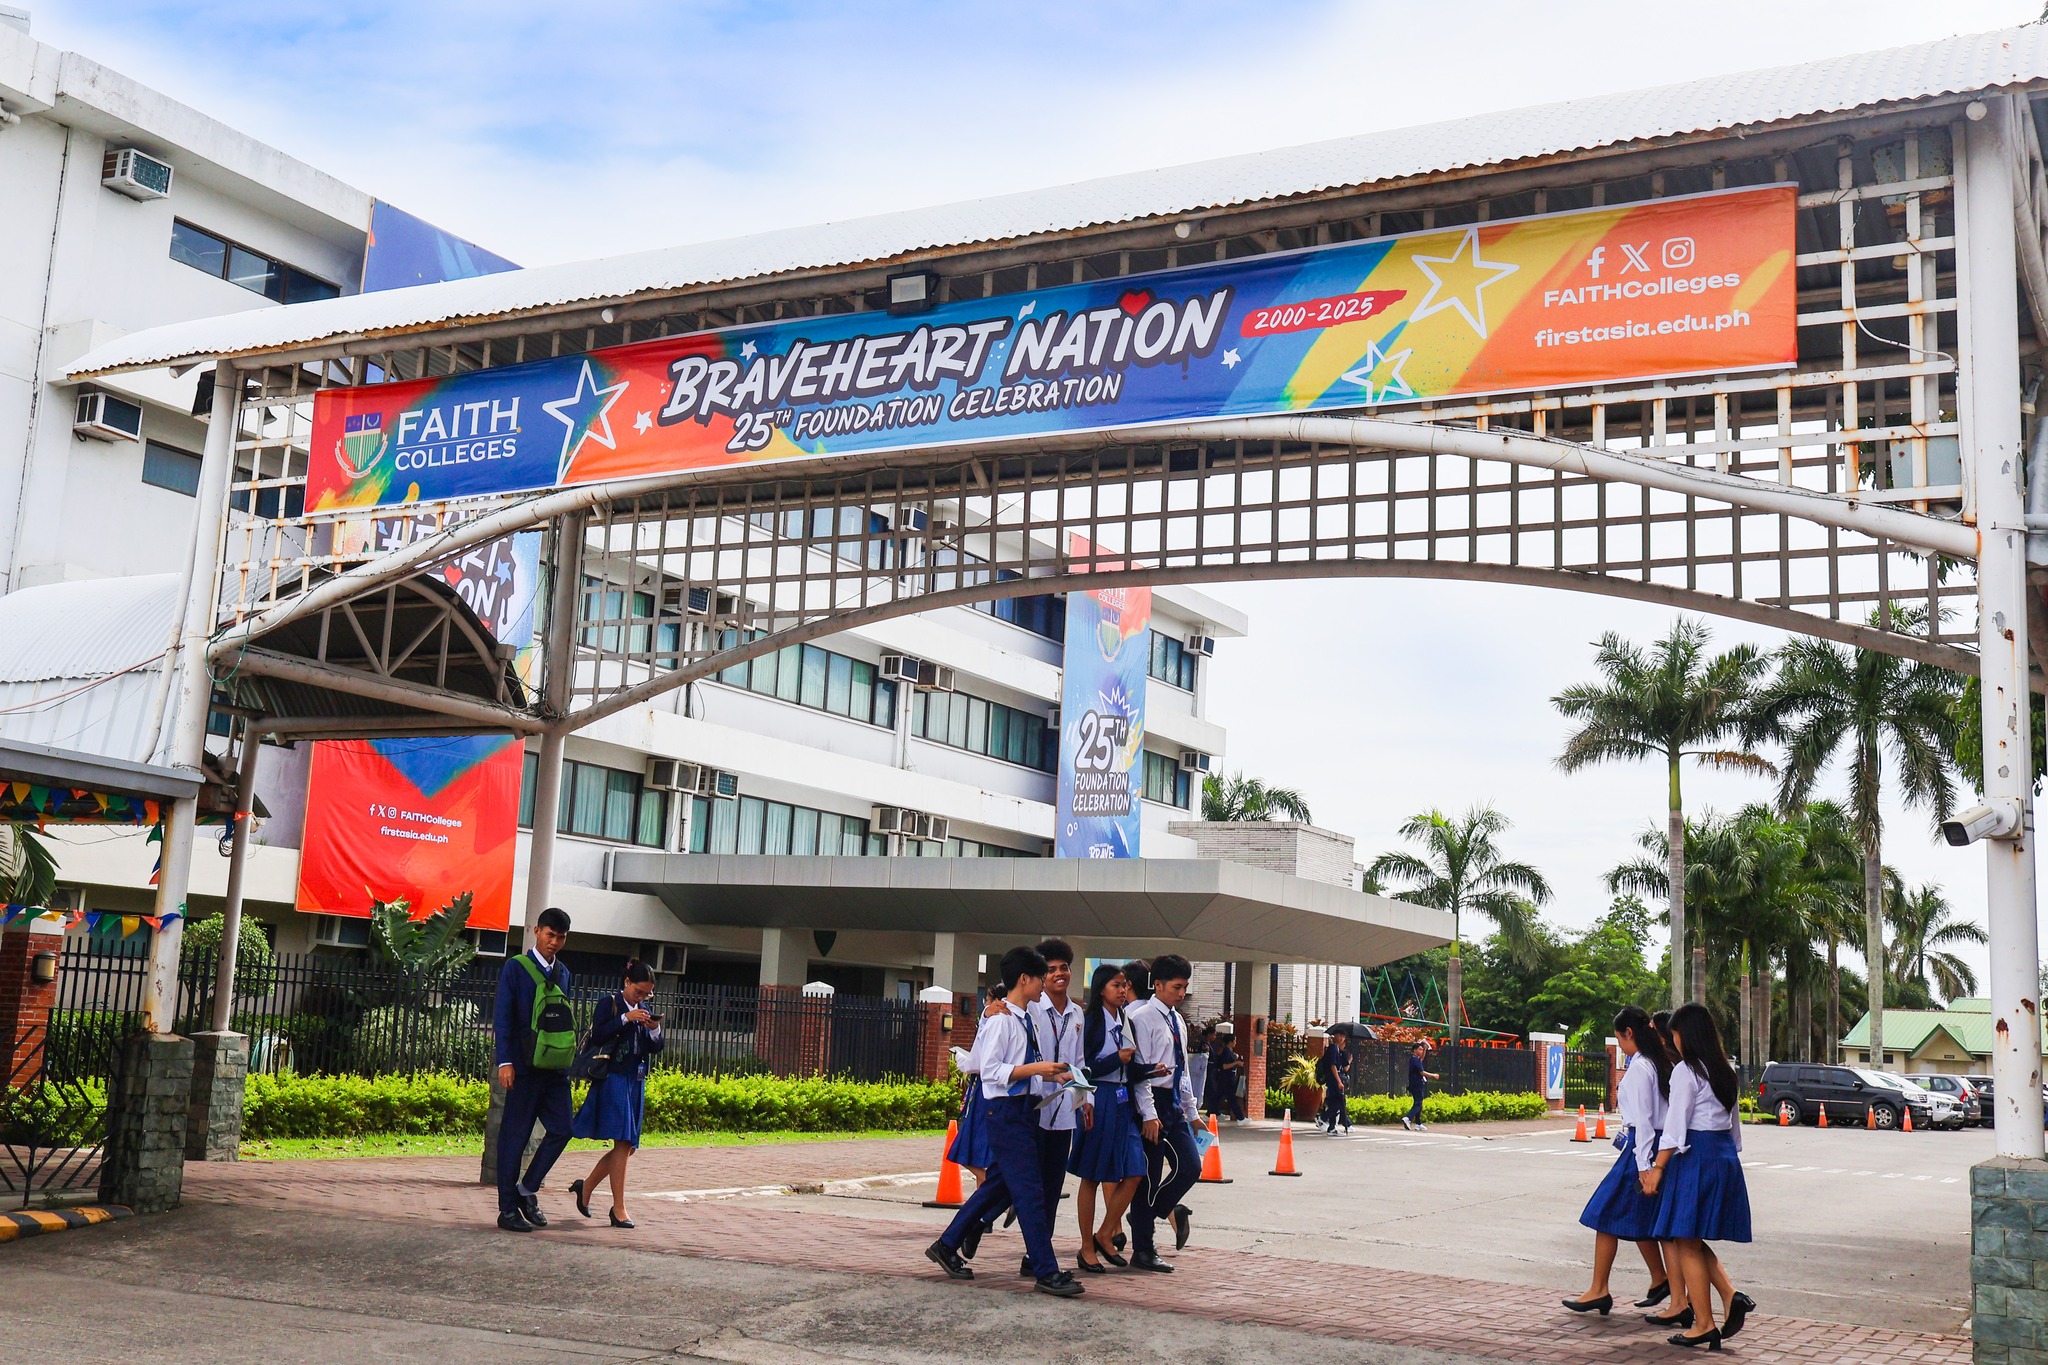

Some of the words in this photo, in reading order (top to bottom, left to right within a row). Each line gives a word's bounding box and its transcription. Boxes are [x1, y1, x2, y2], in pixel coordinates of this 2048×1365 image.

[1543, 272, 1741, 308] FAITHColleges
[1253, 296, 1376, 331] 2000-2025
[1533, 309, 1751, 348] firstasia.edu.ph
[661, 319, 1009, 419] BRAVEHEART
[1005, 289, 1229, 377] NATION
[396, 395, 522, 447] FAITH
[794, 394, 943, 438] FOUNDATION
[949, 373, 1123, 418] CELEBRATION
[394, 437, 518, 472] COLLEGES
[1097, 592, 1126, 611] COLLEGES
[1075, 711, 1128, 771] 25TH
[1074, 772, 1129, 792] FOUNDATION
[400, 810, 463, 828] FAITHColleges
[1072, 792, 1131, 813] CELEBRATION
[380, 826, 449, 845] firstasia.edu.ph
